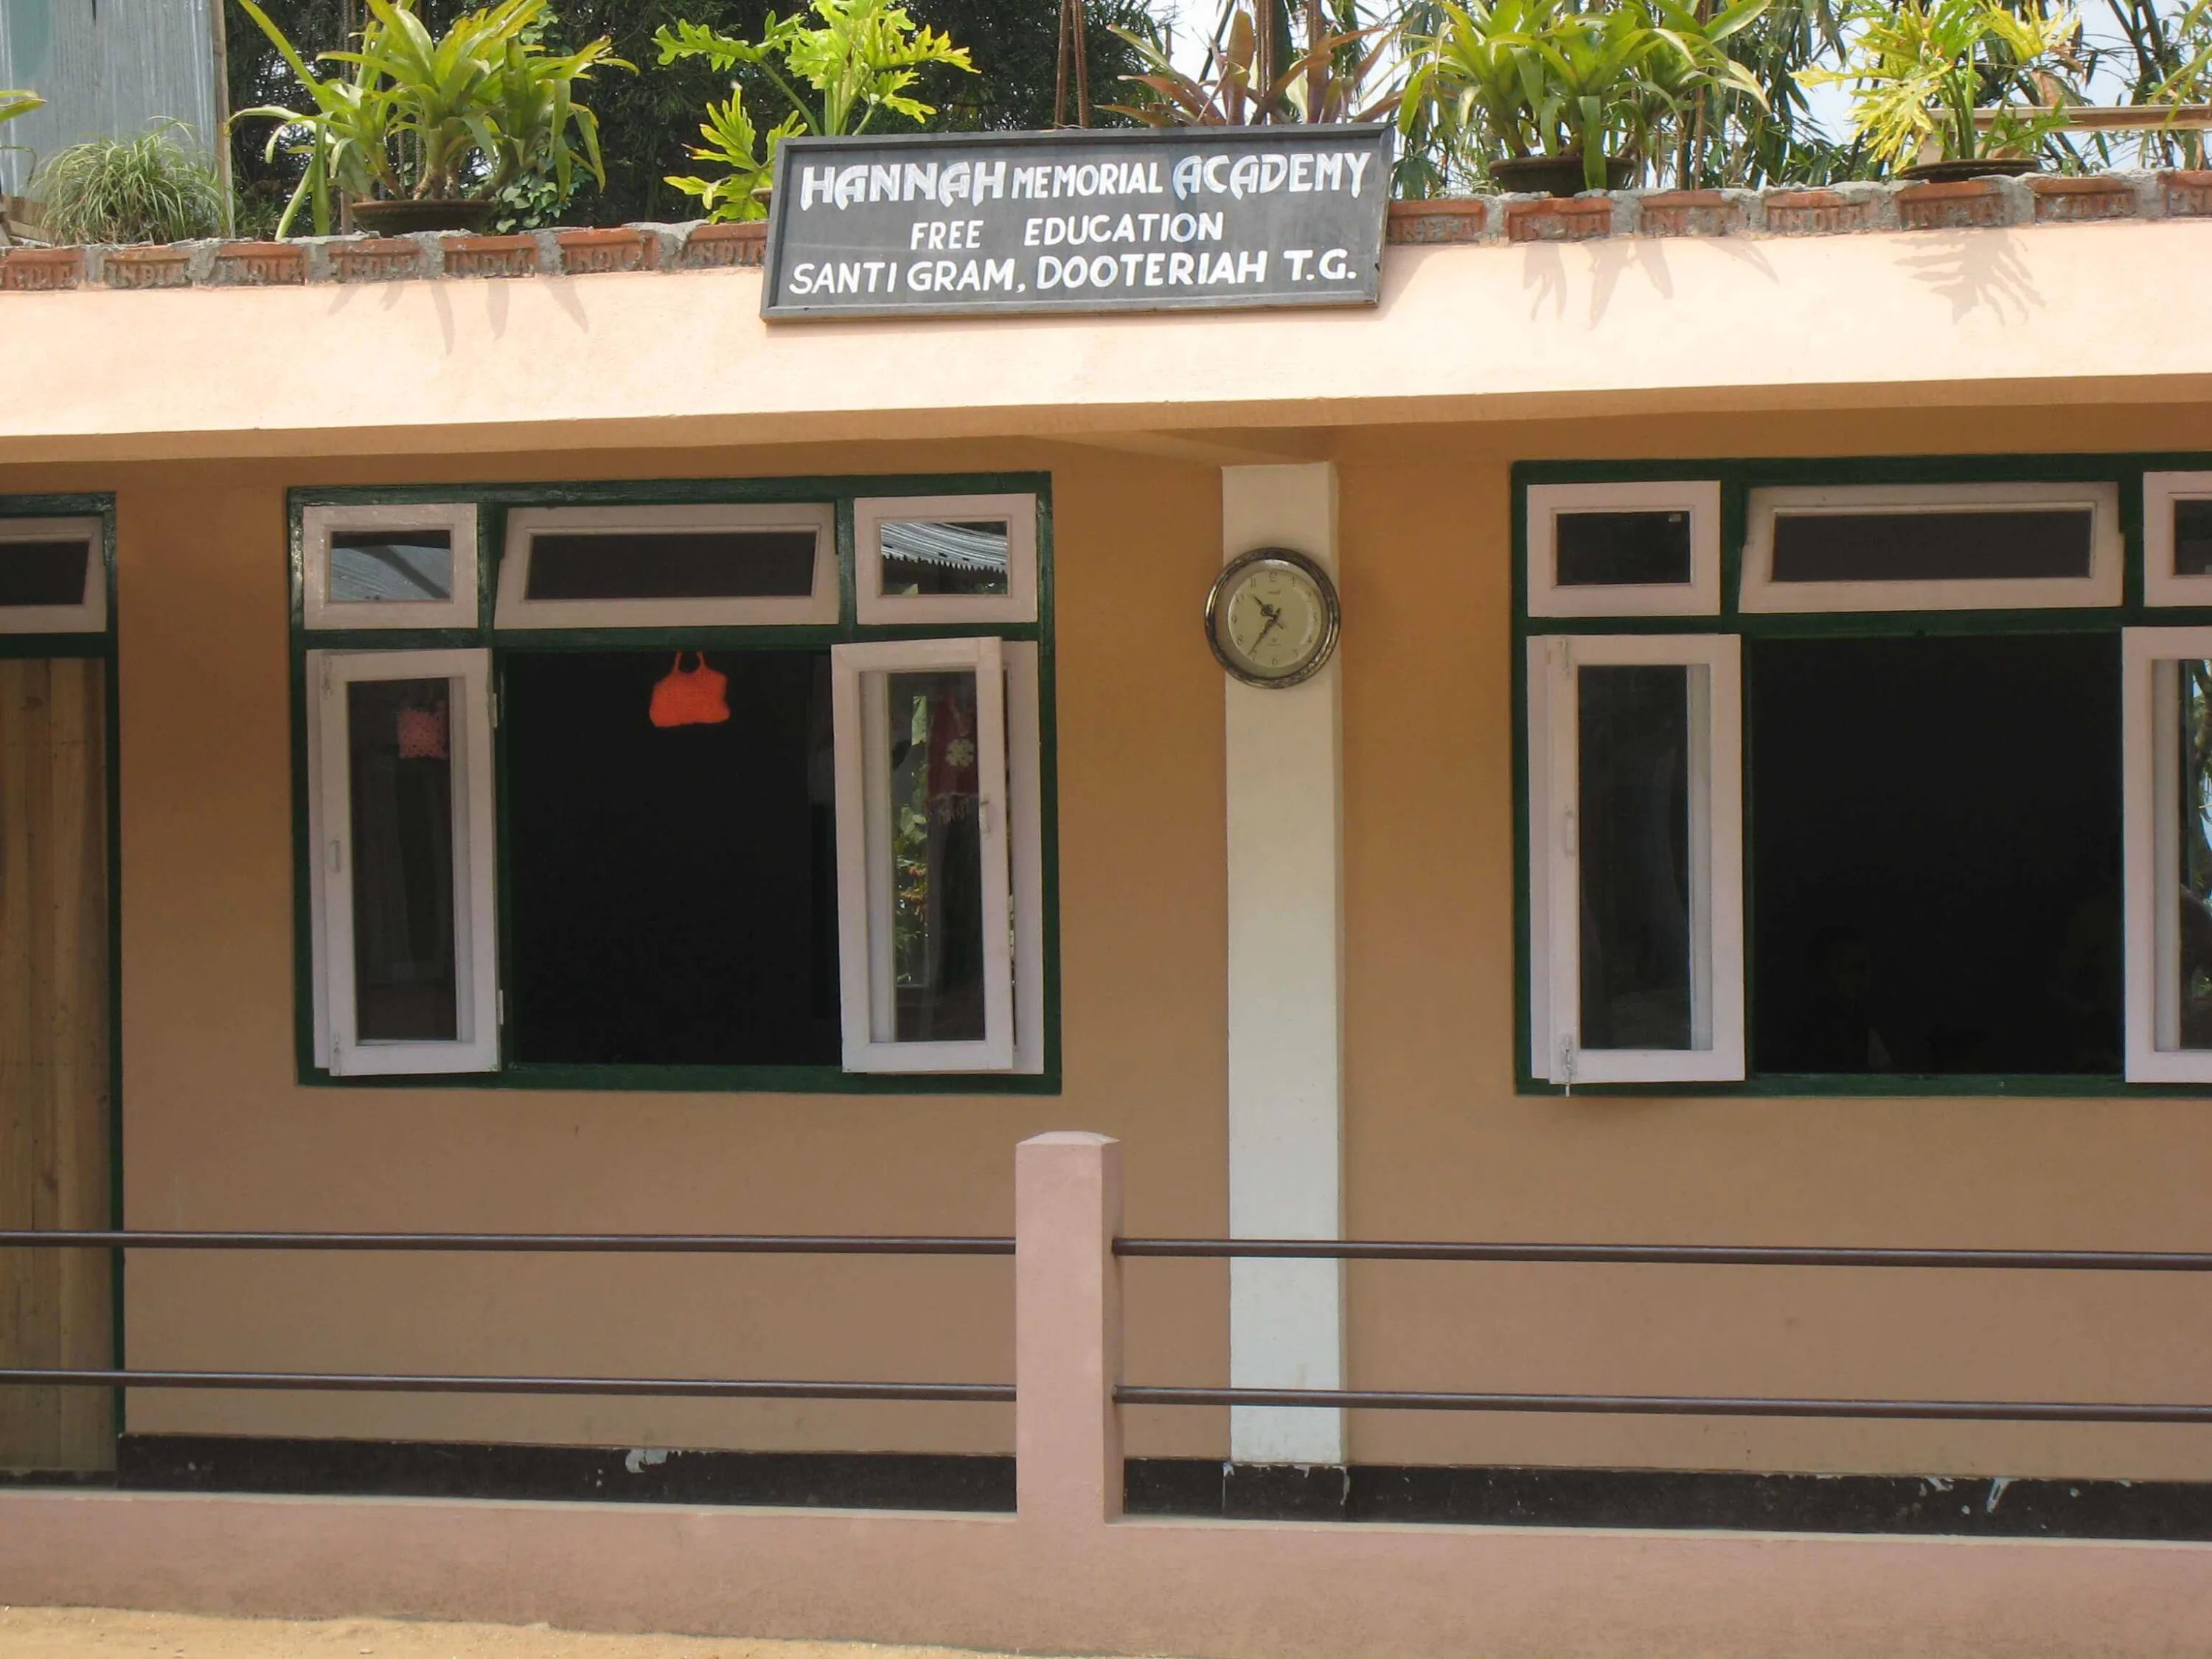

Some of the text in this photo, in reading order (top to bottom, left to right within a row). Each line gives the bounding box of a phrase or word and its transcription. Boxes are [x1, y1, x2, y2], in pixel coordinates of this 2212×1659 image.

[800, 152, 1371, 212] HANNAH MEMORIAL ACADEMY
[910, 211, 1224, 251] FREE EDUCATION
[107, 260, 186, 289] INDIA
[788, 248, 1357, 295] SANTI GRAM, DOOTERIAH T.G.
